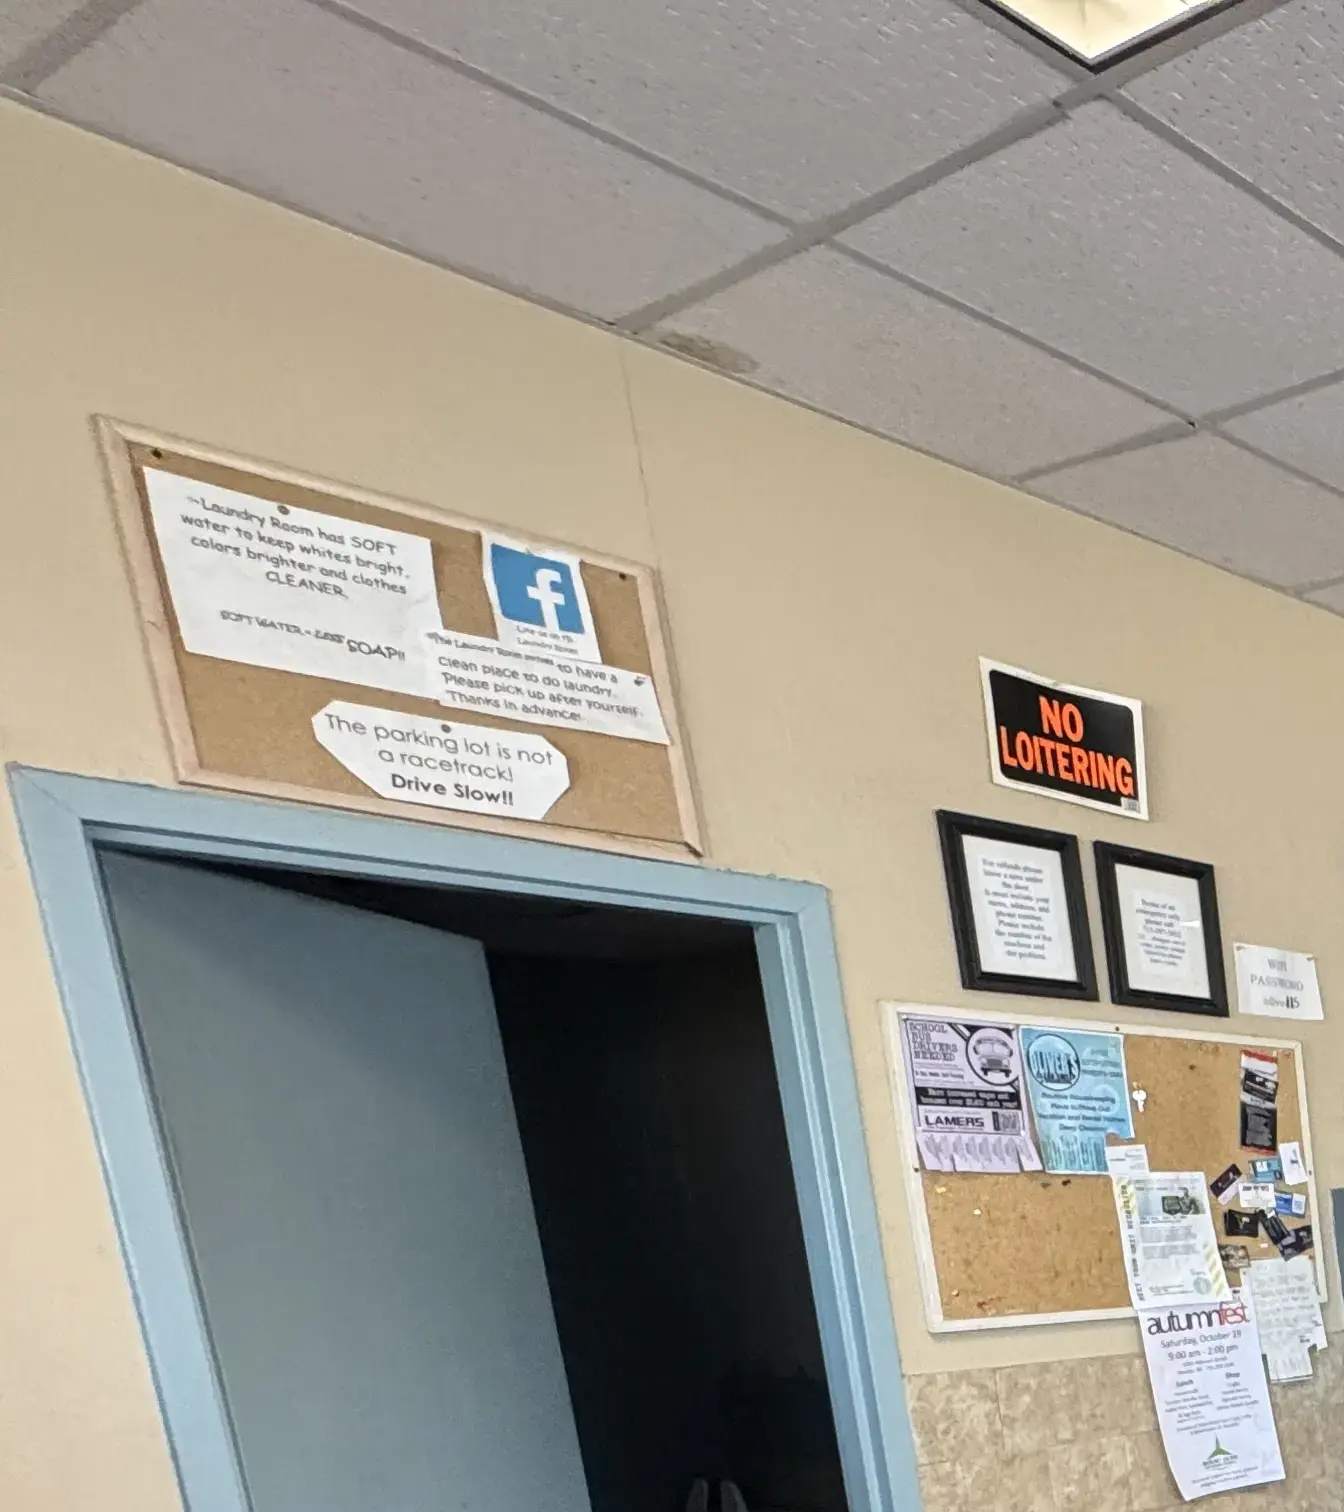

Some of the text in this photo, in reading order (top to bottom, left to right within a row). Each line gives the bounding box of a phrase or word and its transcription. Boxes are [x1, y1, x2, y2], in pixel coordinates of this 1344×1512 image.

[181, 513, 230, 536] water
[235, 524, 253, 541] to
[257, 531, 295, 552] keep
[299, 542, 351, 564] whites
[270, 516, 314, 537] Room
[318, 527, 345, 545] has
[351, 536, 397, 556] SOFT
[191, 535, 407, 595] colors brighter and clothes
[481, 664, 519, 682] place
[522, 672, 539, 684] to
[542, 672, 560, 688] do
[557, 664, 573, 675] to
[576, 665, 606, 682] have
[609, 672, 618, 684] a
[441, 671, 490, 692] Please
[493, 680, 525, 698] pick
[527, 688, 546, 702] up
[548, 690, 583, 708] after
[445, 689, 501, 709] Thanks
[504, 698, 518, 711] in
[1039, 695, 1084, 743] NO
[325, 713, 554, 766] The parking lot is not
[378, 750, 514, 783] a racetrack!
[1000, 725, 1135, 798] LOITERING
[391, 773, 514, 807] Drive Slow!!
[1250, 973, 1305, 992] PASSWORD
[909, 1022, 948, 1034] SCHOOL
[911, 1032, 932, 1042] BUS
[913, 1041, 958, 1053] DRIVERS
[914, 1050, 956, 1061] NEEDED
[924, 1115, 986, 1128] LAMERS
[1147, 1301, 1251, 1336] autumnfest
[1160, 1337, 1198, 1348] Saturday,
[1199, 1332, 1230, 1343] October
